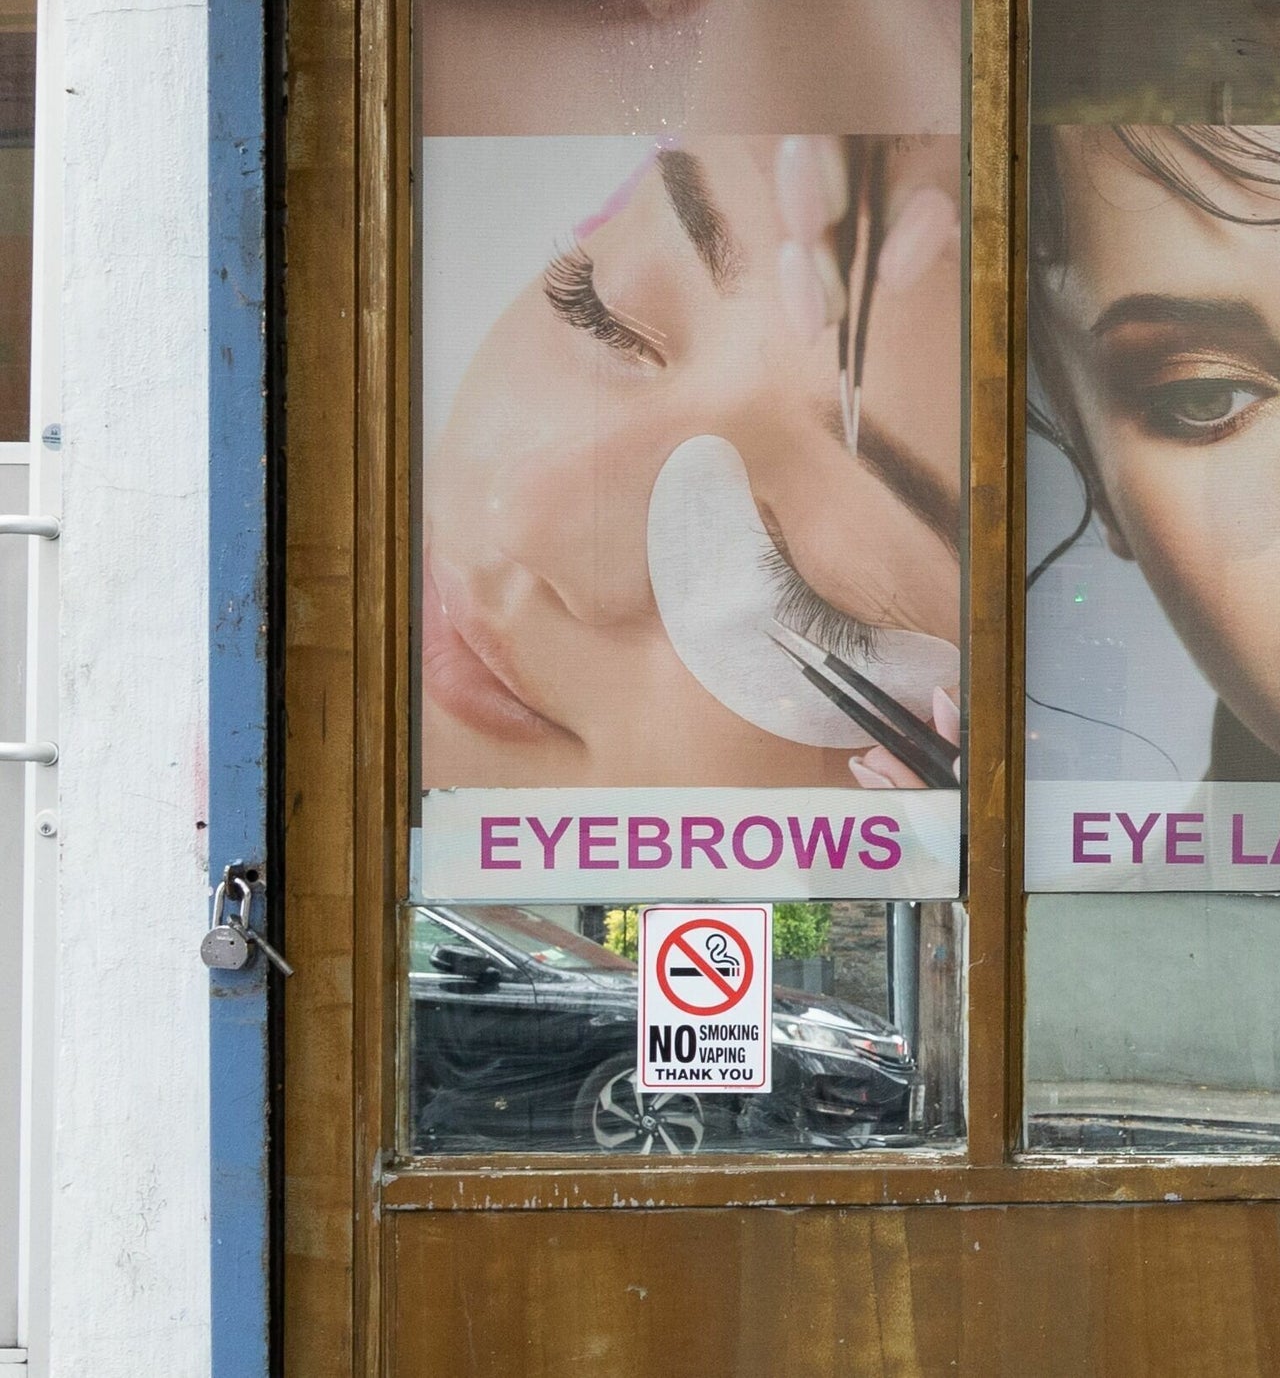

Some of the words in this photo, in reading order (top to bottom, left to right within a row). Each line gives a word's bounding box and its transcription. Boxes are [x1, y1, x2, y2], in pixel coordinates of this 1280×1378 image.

[480, 815, 903, 871] EYEBROWS
[1072, 813, 1204, 864] EYE
[649, 1024, 697, 1063] NO
[699, 1024, 759, 1041] SMOKING
[699, 1047, 746, 1063] VAPING
[655, 1068, 712, 1080] THANK
[718, 1068, 753, 1080] YOU
